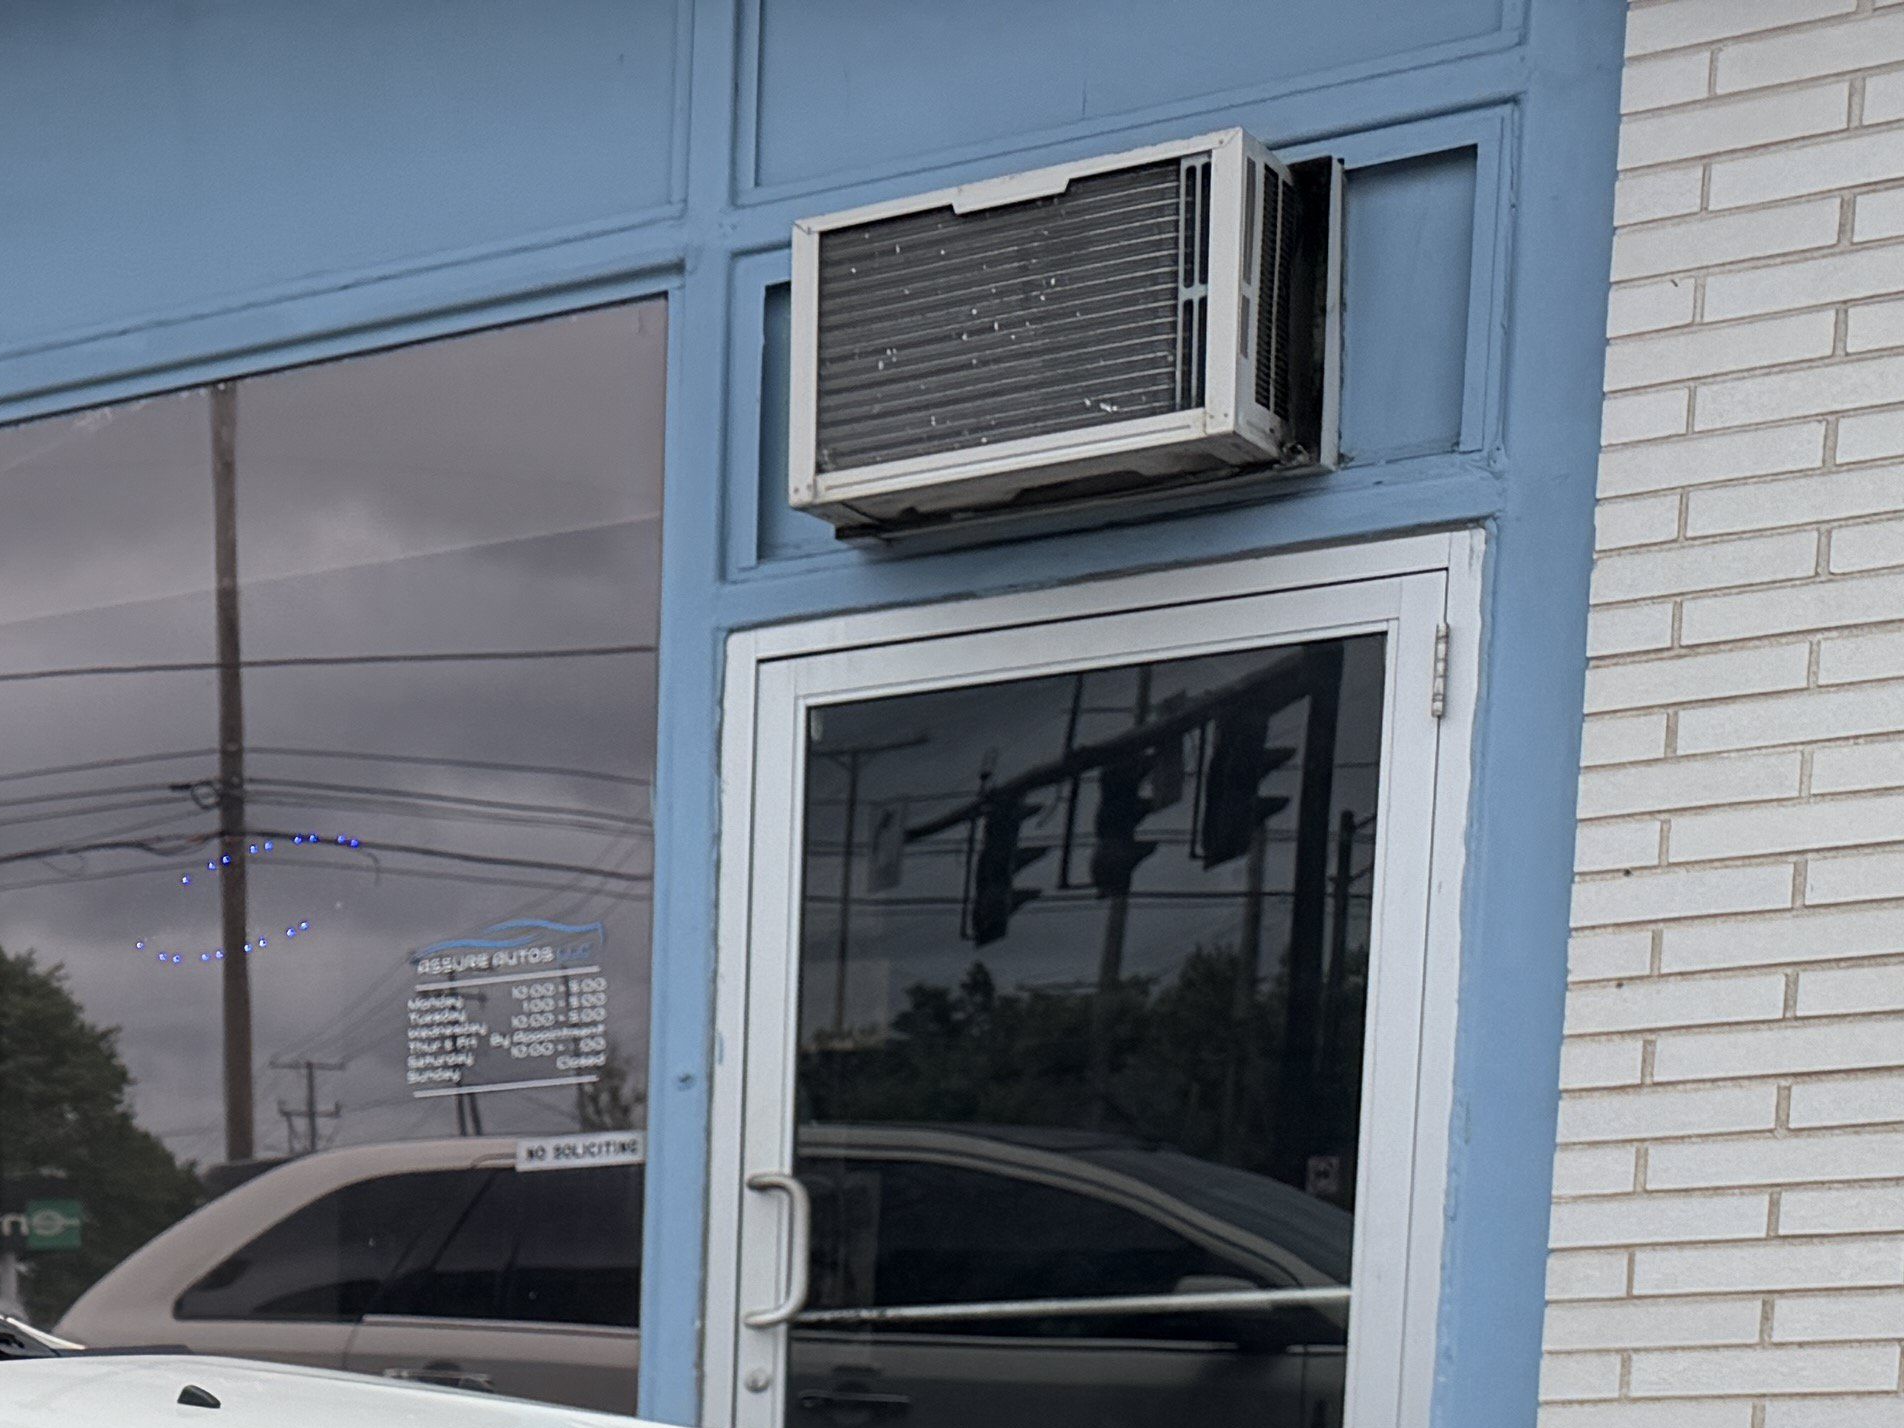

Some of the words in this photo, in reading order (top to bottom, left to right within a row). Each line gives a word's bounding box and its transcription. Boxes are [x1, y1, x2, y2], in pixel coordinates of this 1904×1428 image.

[492, 946, 555, 967] AUTOS
[407, 995, 465, 1011] Monday
[408, 1009, 468, 1025] Tuesday
[408, 1022, 489, 1040] Wednesday
[512, 1023, 606, 1044] Appointment
[407, 1052, 476, 1069] Saturday
[407, 1068, 463, 1085] Sunday
[556, 1052, 607, 1070] Closed
[527, 1145, 545, 1160] NO
[552, 1139, 638, 1159] SOLICITING
